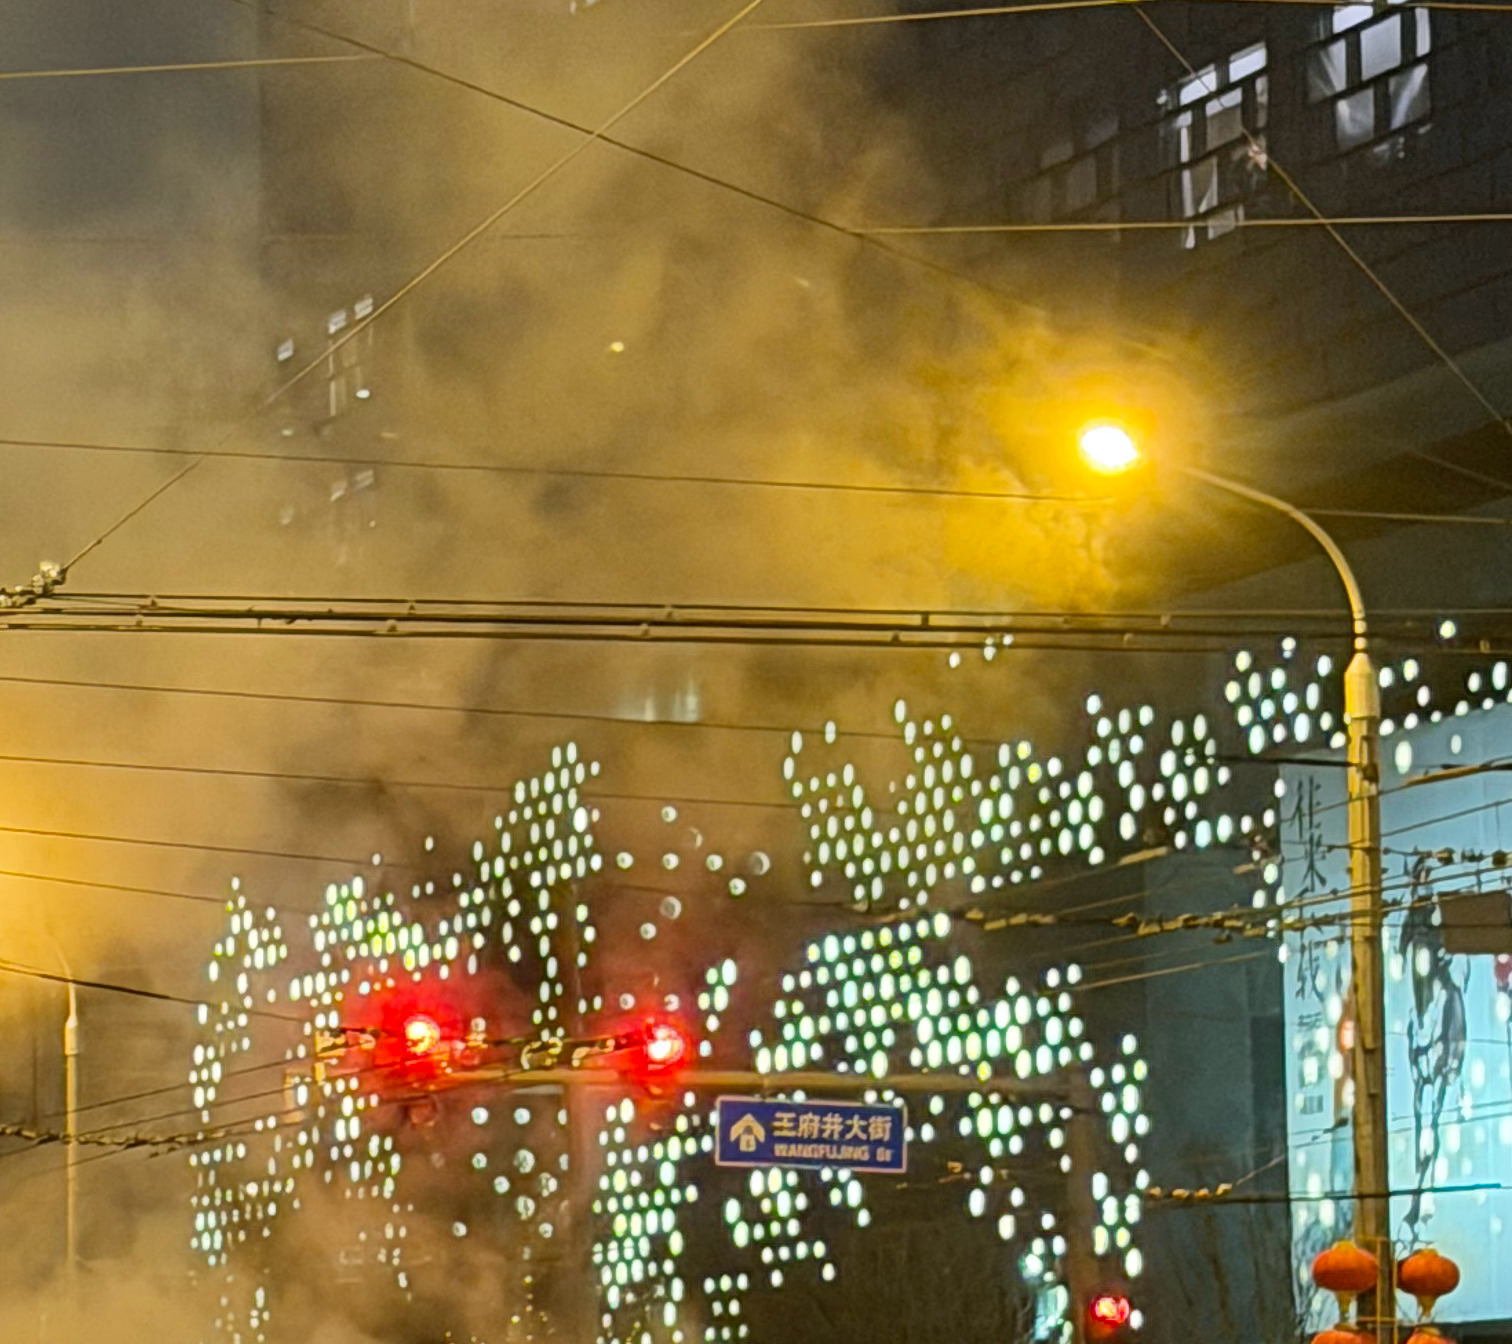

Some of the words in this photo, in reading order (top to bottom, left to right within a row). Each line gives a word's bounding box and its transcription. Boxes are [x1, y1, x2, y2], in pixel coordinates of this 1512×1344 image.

[772, 1111, 892, 1142] 王府井大街
[774, 1143, 869, 1161] WANGFUJING
